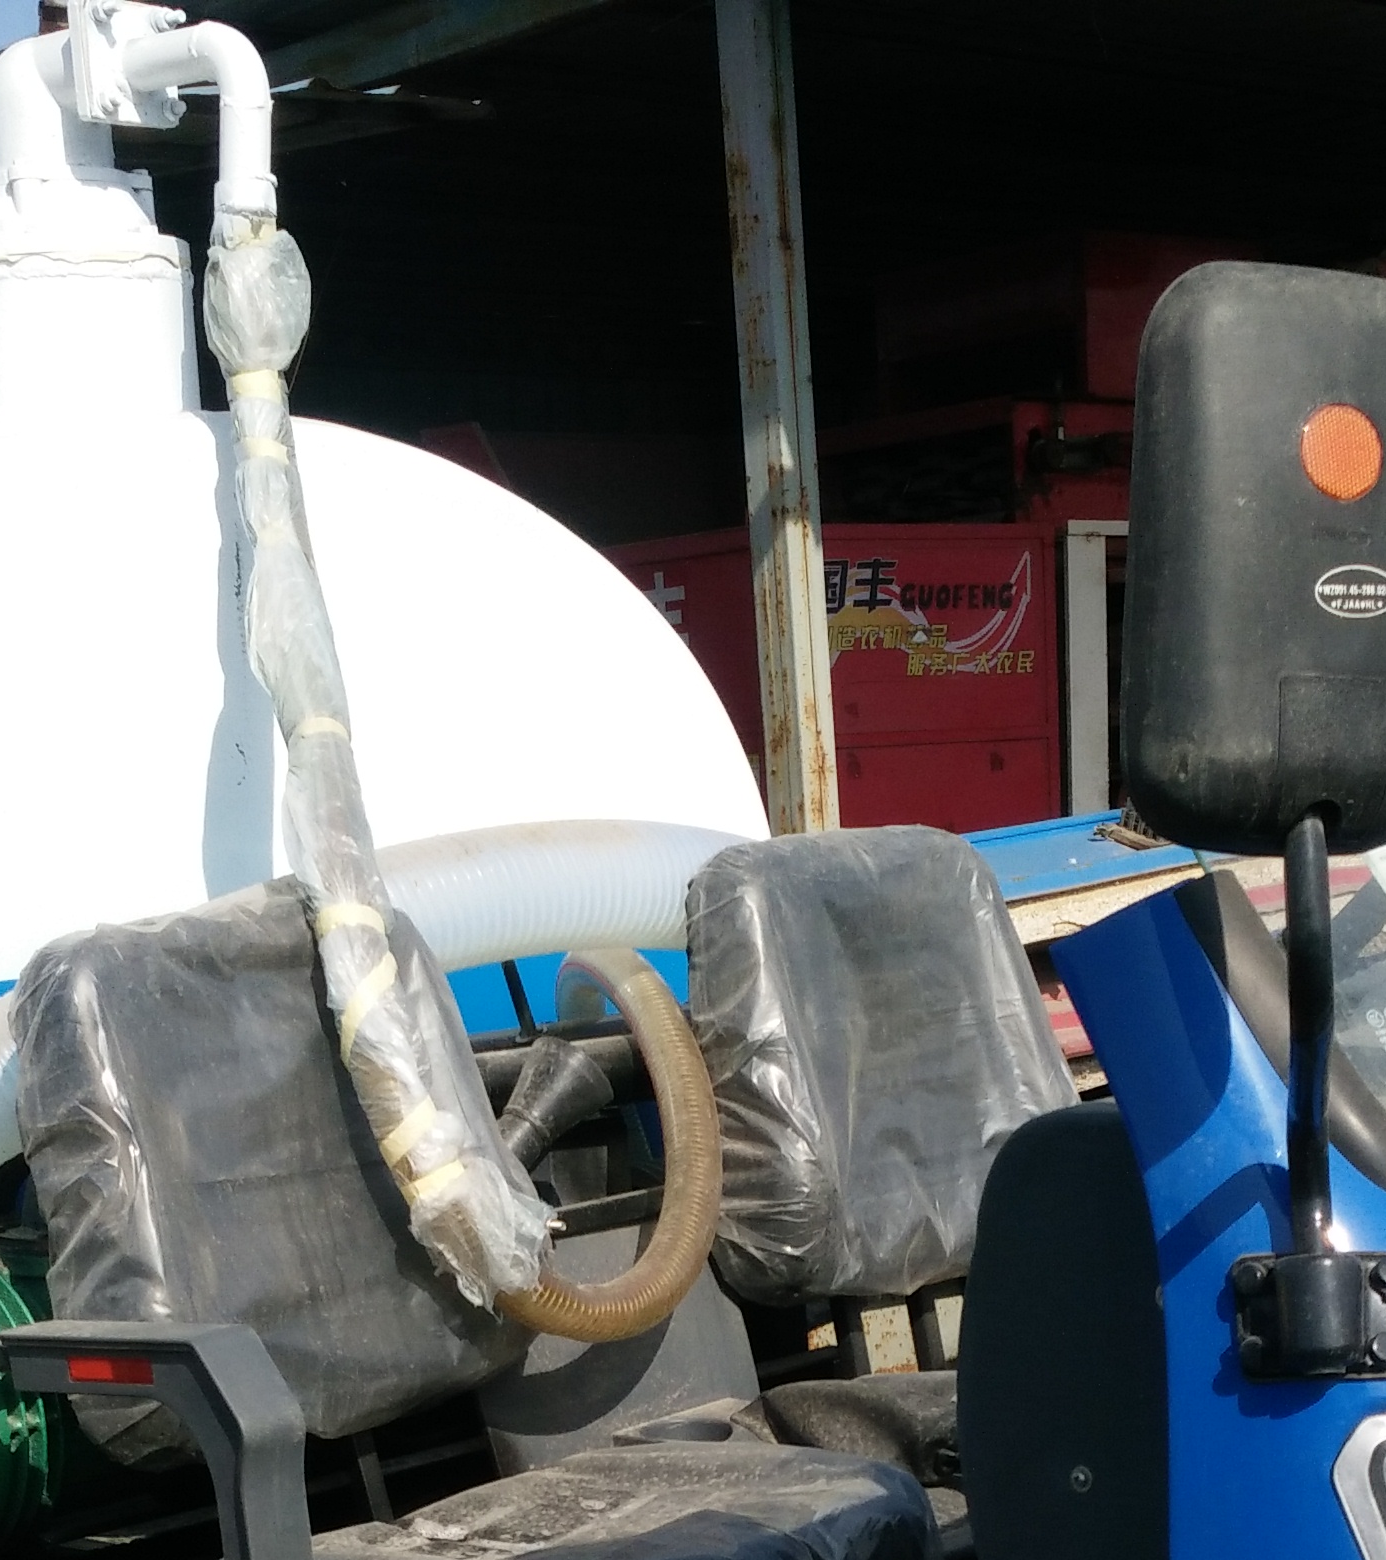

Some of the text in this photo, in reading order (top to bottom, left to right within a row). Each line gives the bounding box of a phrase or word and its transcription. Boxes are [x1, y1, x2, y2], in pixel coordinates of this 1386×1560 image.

[899, 581, 1015, 611] GUOFENG
[906, 650, 1036, 677] 服务广大农民
